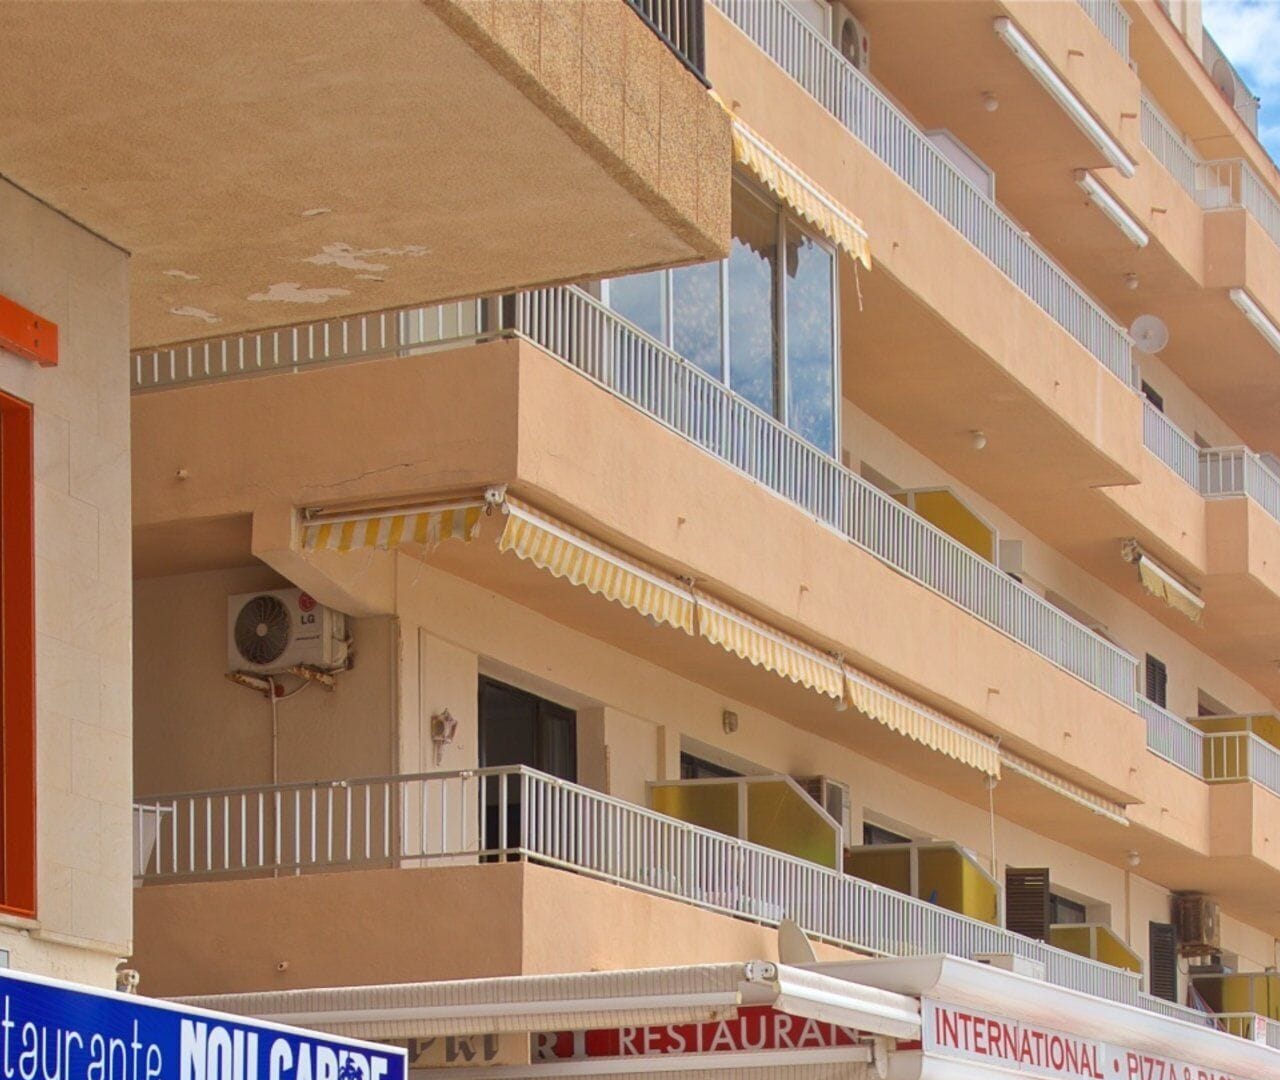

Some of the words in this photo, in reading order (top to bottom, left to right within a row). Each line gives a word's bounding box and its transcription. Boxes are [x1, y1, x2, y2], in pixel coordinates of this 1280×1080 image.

[301, 614, 315, 624] LG
[619, 1014, 863, 1056] RESTAURAN
[935, 1007, 1104, 1079] INTERNATIONAL
